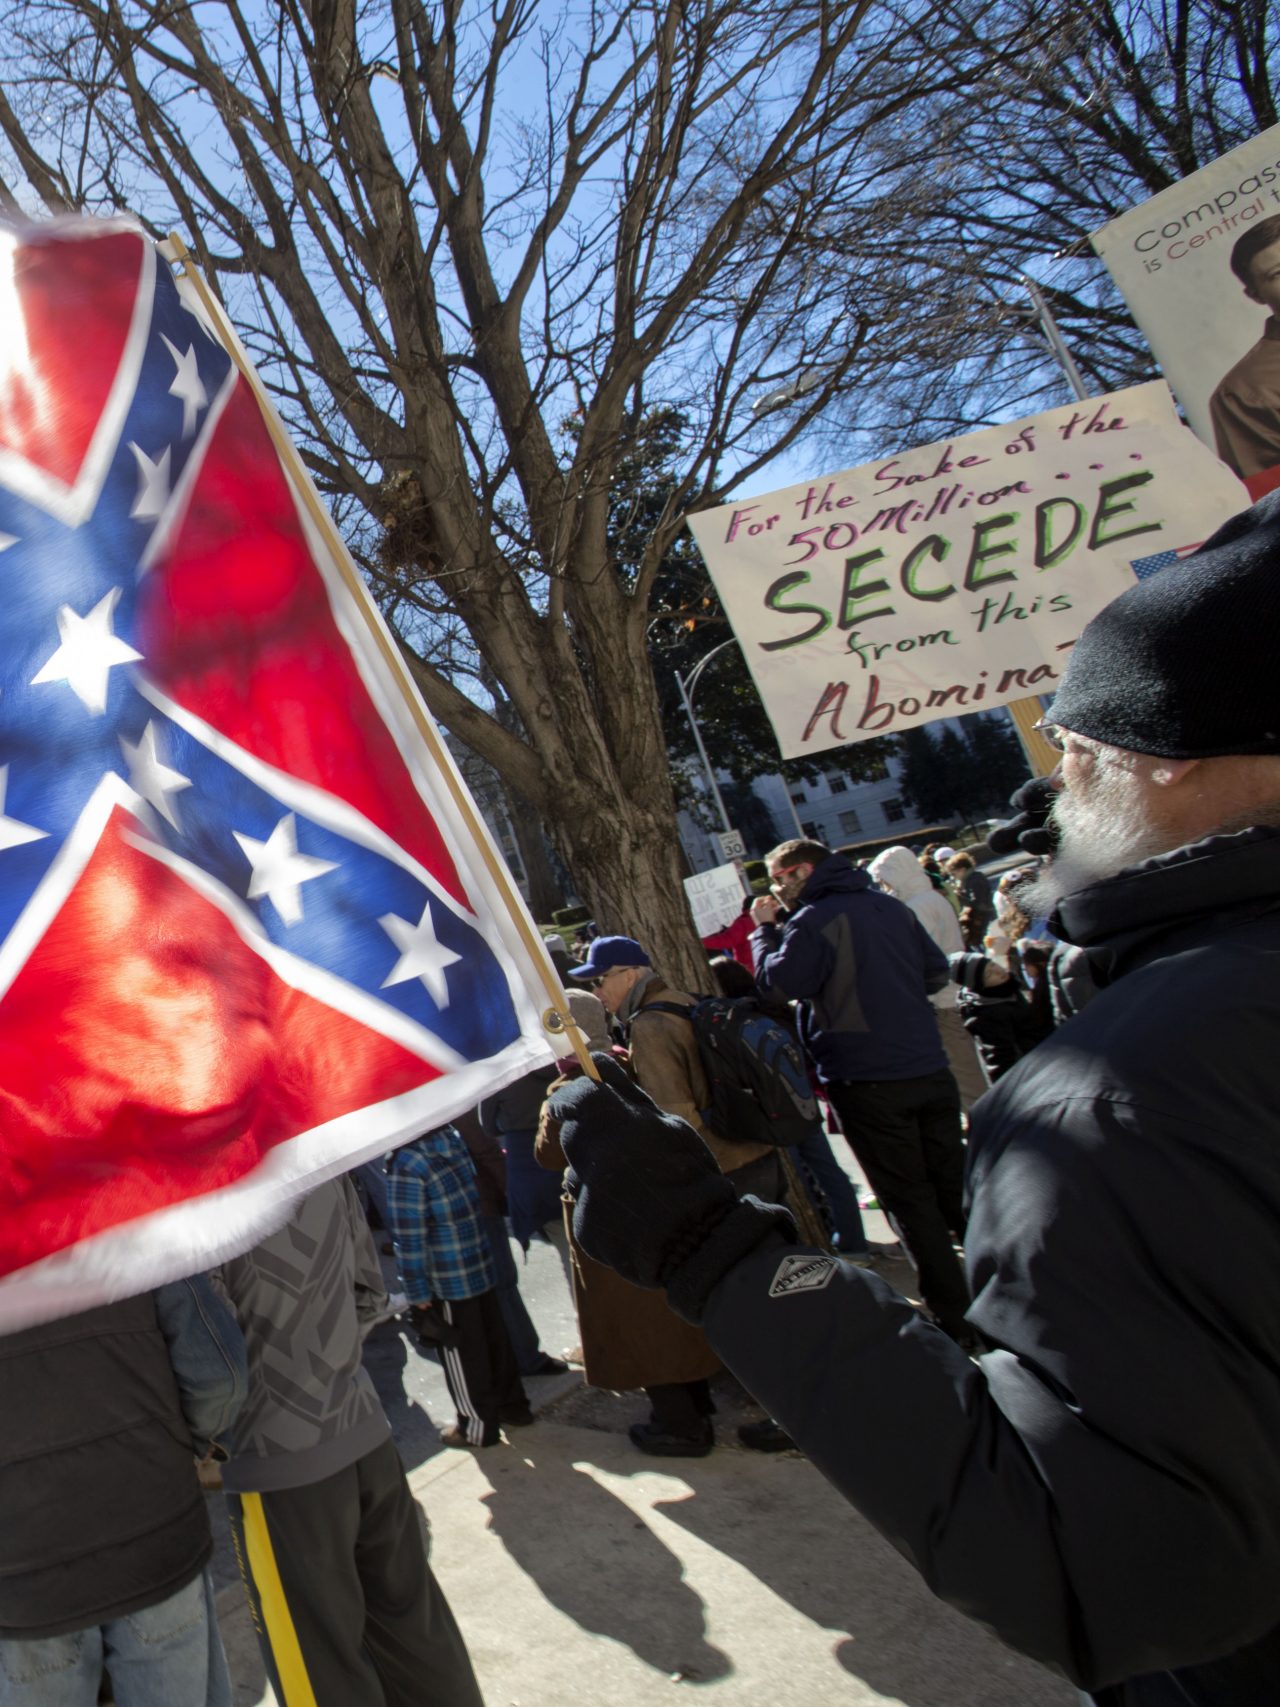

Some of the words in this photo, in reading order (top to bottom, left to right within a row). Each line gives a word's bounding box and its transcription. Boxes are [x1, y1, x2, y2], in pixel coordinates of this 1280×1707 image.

[1143, 259, 1163, 274] is
[1167, 197, 1266, 260] Central
[724, 504, 781, 544] For
[796, 482, 862, 521] the
[873, 445, 992, 497] Sake
[1005, 425, 1036, 455] of
[1059, 402, 1129, 440] the
[758, 470, 1165, 652] SECEDE
[783, 522, 859, 566] 50
[844, 631, 960, 669] from
[971, 591, 1073, 632] this
[800, 639, 1077, 742] Abomina
[724, 843, 742, 856] 30
